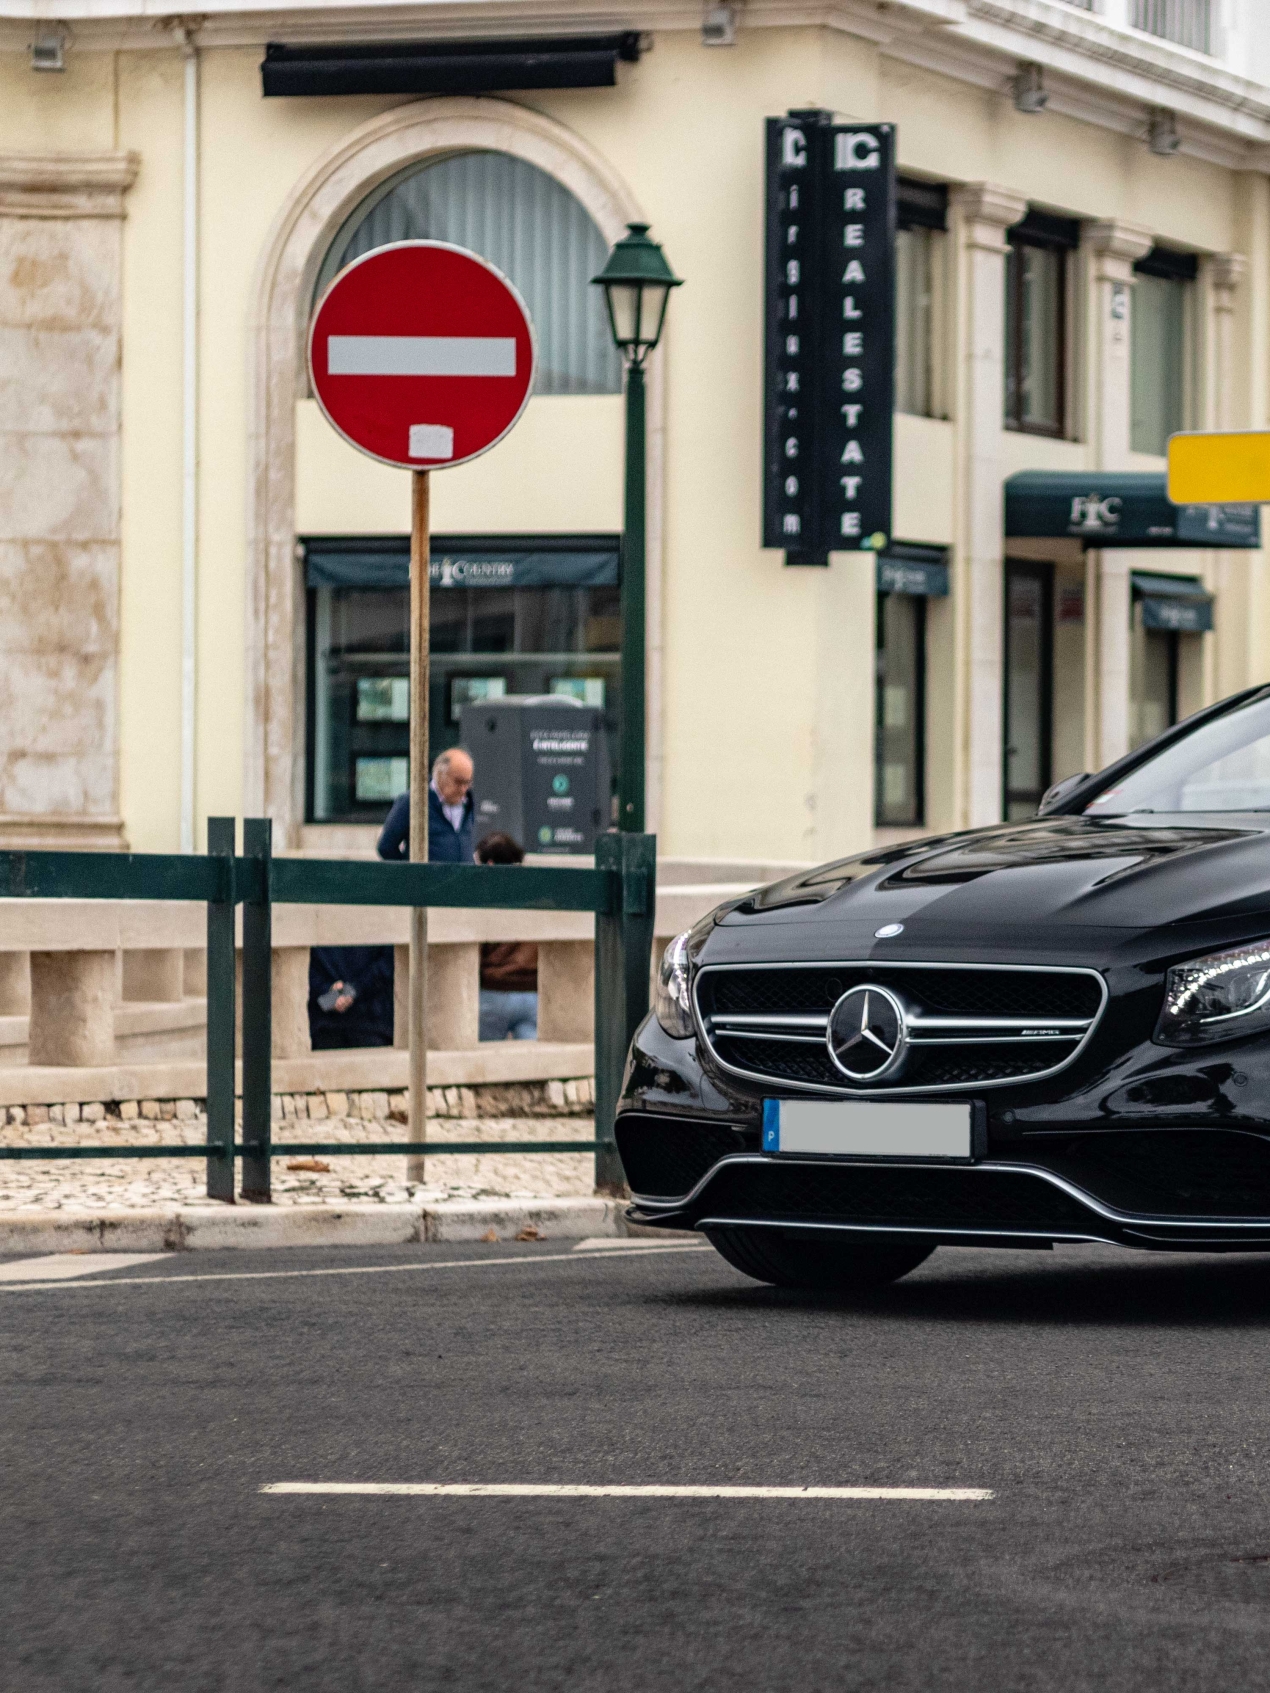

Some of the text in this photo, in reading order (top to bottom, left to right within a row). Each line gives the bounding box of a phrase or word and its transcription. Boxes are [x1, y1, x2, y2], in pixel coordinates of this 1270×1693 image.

[839, 187, 867, 537] REAL ESTATE
[768, 1131, 775, 1142] P
